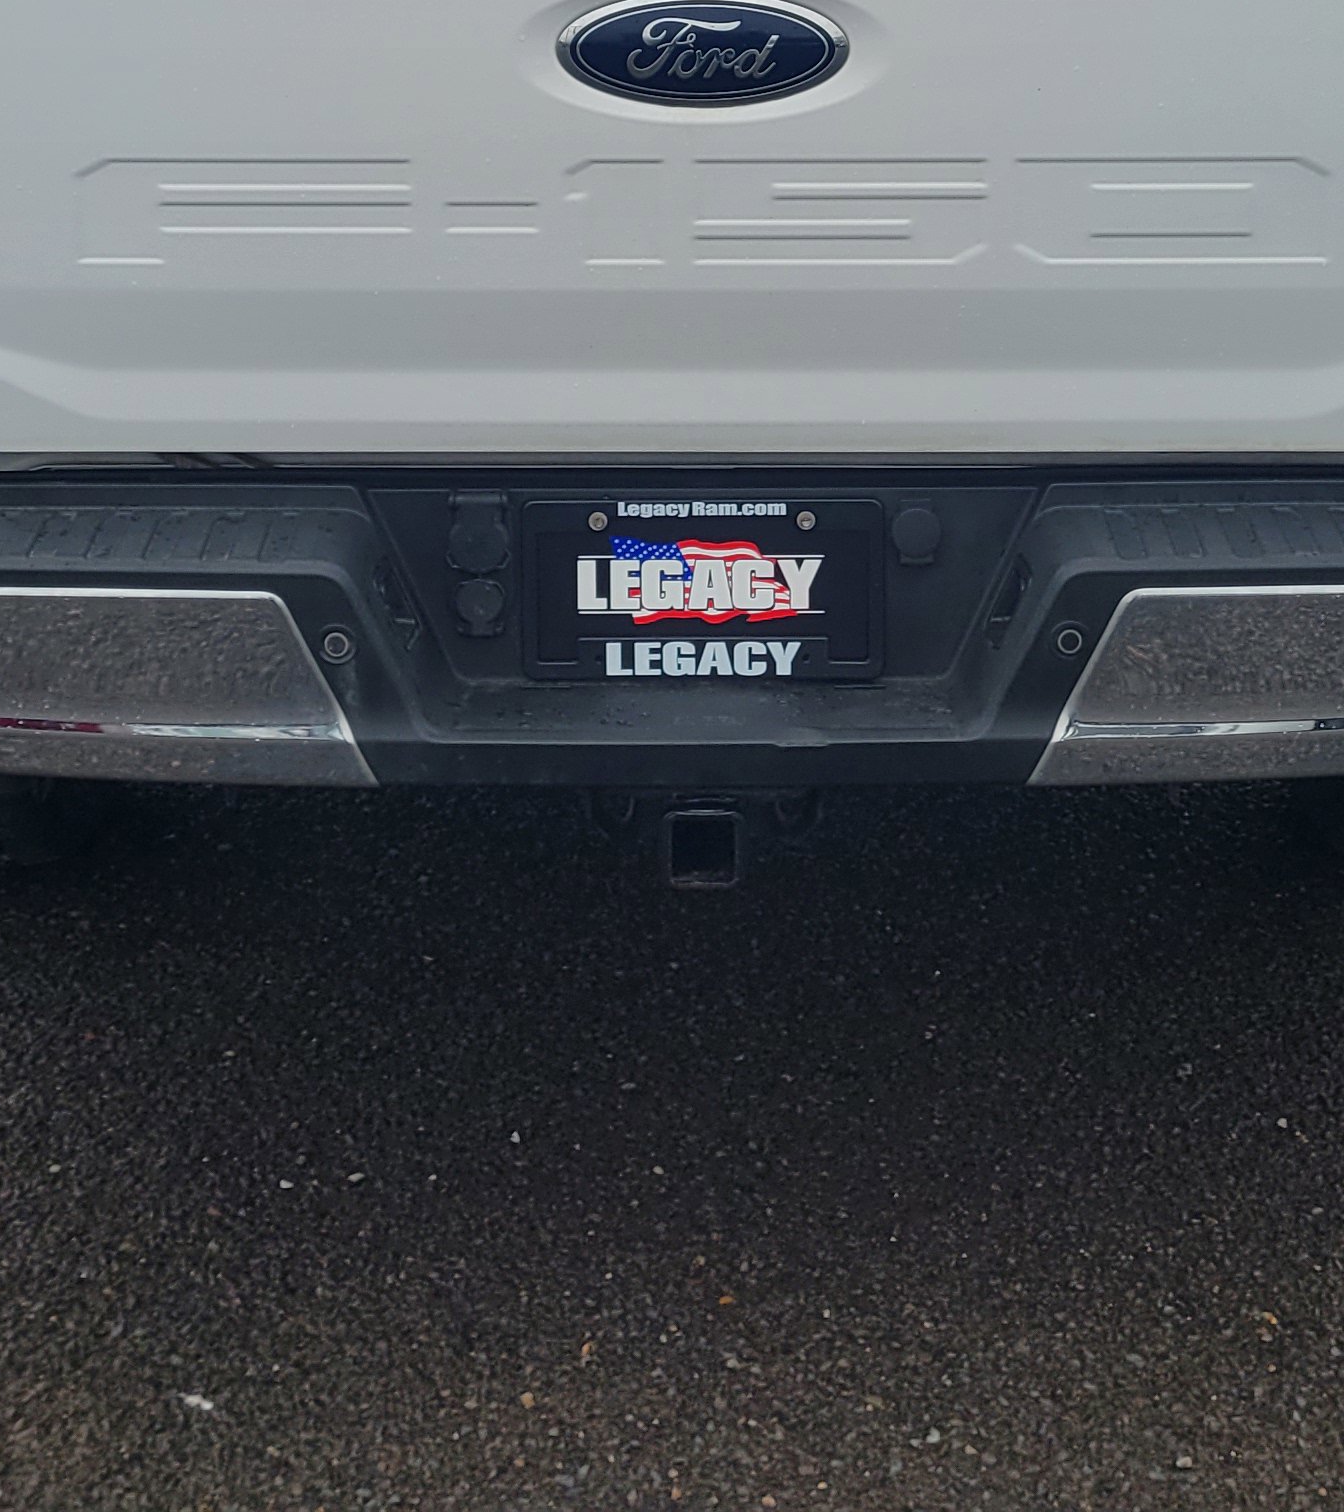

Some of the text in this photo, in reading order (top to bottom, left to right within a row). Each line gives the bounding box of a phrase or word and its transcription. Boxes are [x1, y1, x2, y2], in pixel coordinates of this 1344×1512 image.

[627, 17, 779, 79] Ford
[74, 157, 1332, 266] F-150
[577, 559, 823, 610] LEGACY
[605, 641, 801, 676] LEGACY
